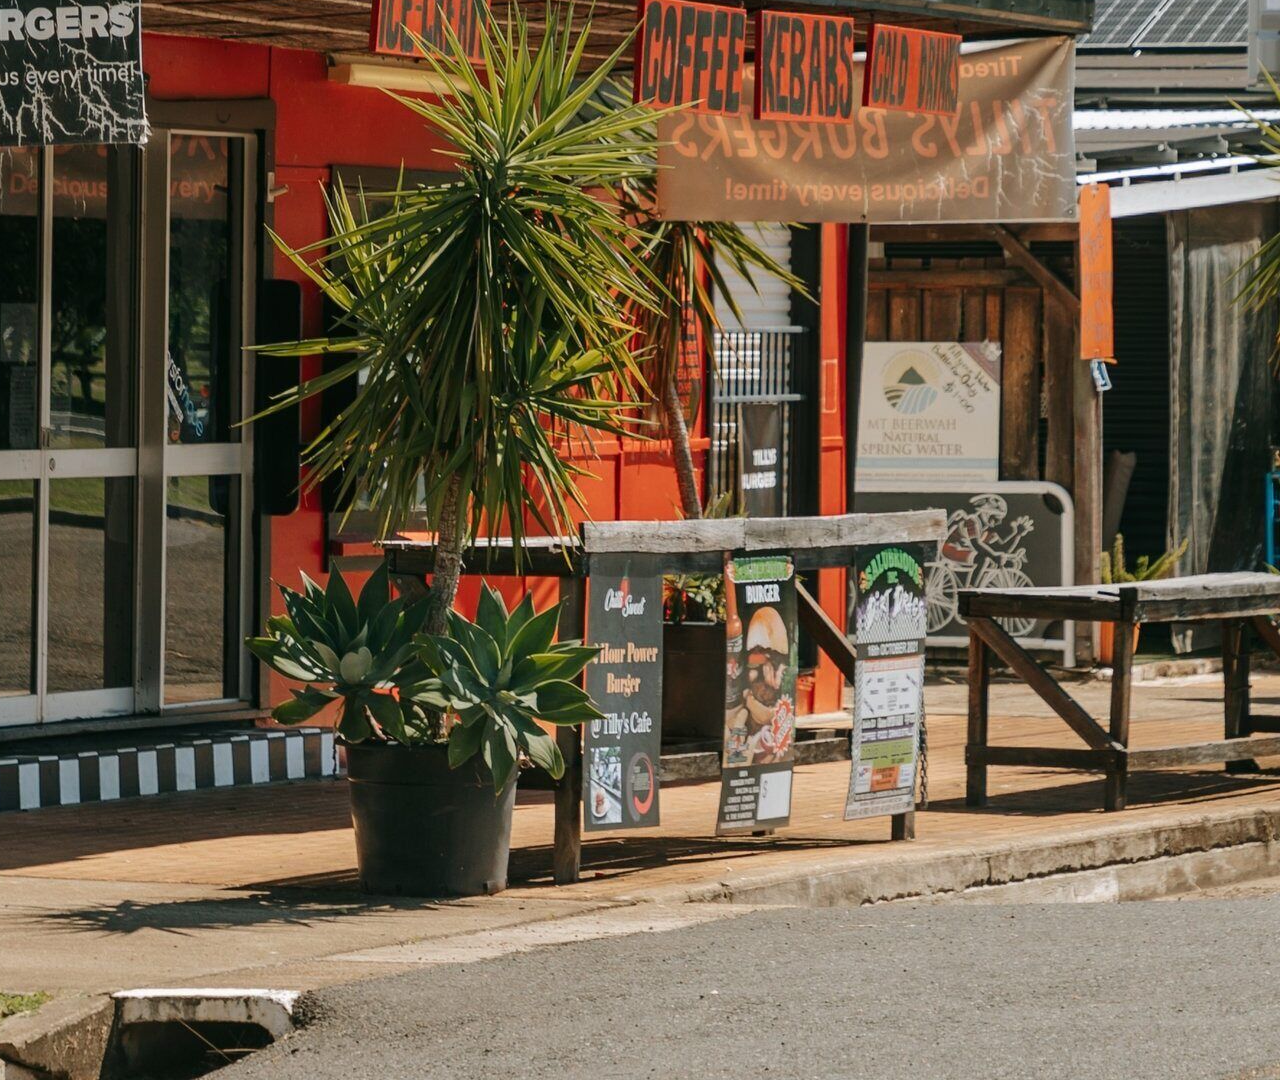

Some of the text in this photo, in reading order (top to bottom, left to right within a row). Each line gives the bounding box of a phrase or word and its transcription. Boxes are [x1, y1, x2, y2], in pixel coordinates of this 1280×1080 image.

[642, 1, 744, 113] COFFEE
[762, 15, 853, 119] KEBABS
[872, 30, 909, 106] COLD
[26, 67, 79, 91] every
[84, 62, 135, 83] time!
[867, 418, 957, 431] MT BEERWAH
[860, 443, 964, 456] SPRING WATER
[745, 583, 781, 604] BURGER
[627, 641, 659, 664] Power
[606, 672, 641, 697] Burger
[630, 711, 653, 734] Cafe
